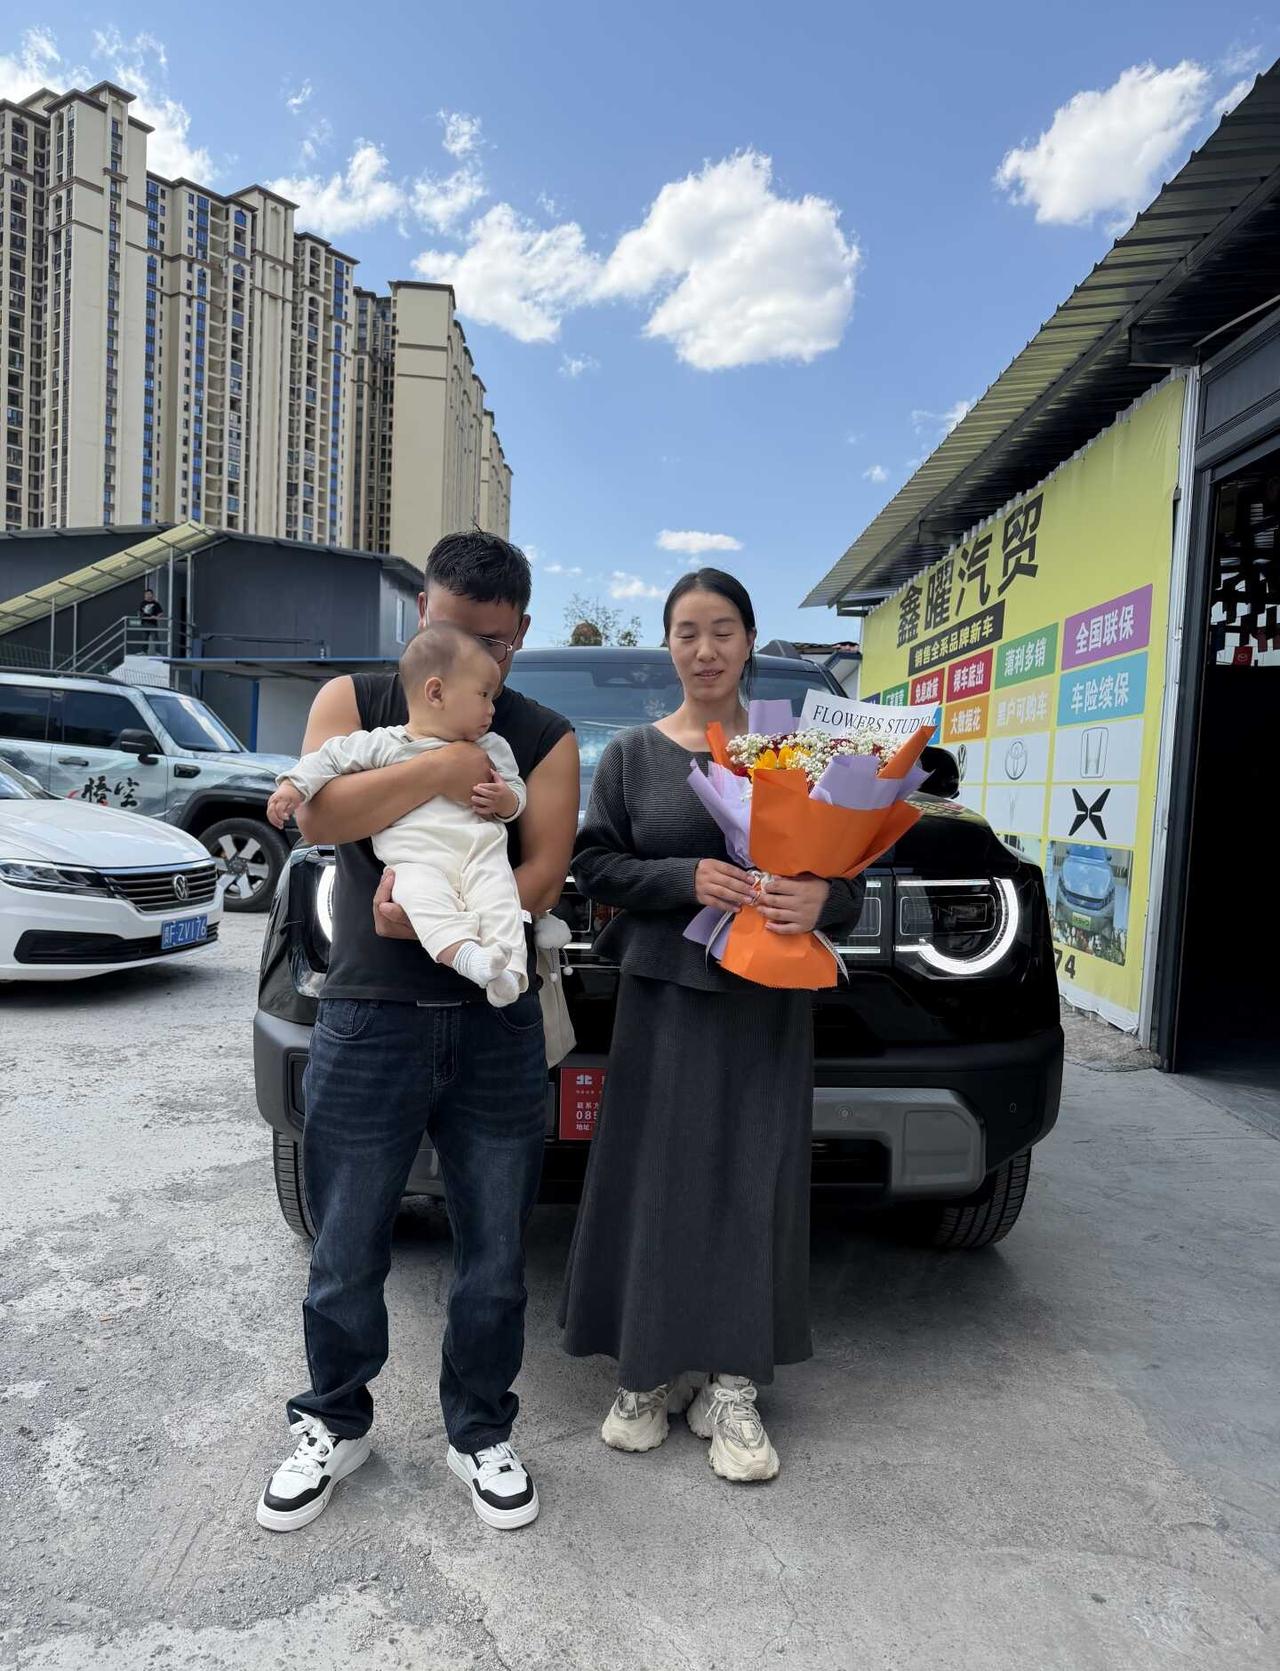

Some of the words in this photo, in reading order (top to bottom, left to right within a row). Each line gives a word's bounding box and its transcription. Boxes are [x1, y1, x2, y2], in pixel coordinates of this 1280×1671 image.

[897, 492, 1044, 648] 鑫曜汽贸
[914, 615, 994, 668] 销售全系品牌新车
[1075, 604, 1134, 655] 全国联保
[1004, 637, 1047, 677] 薄利多销
[1071, 672, 1129, 714] 车险续保
[812, 704, 884, 732] FLOWERS
